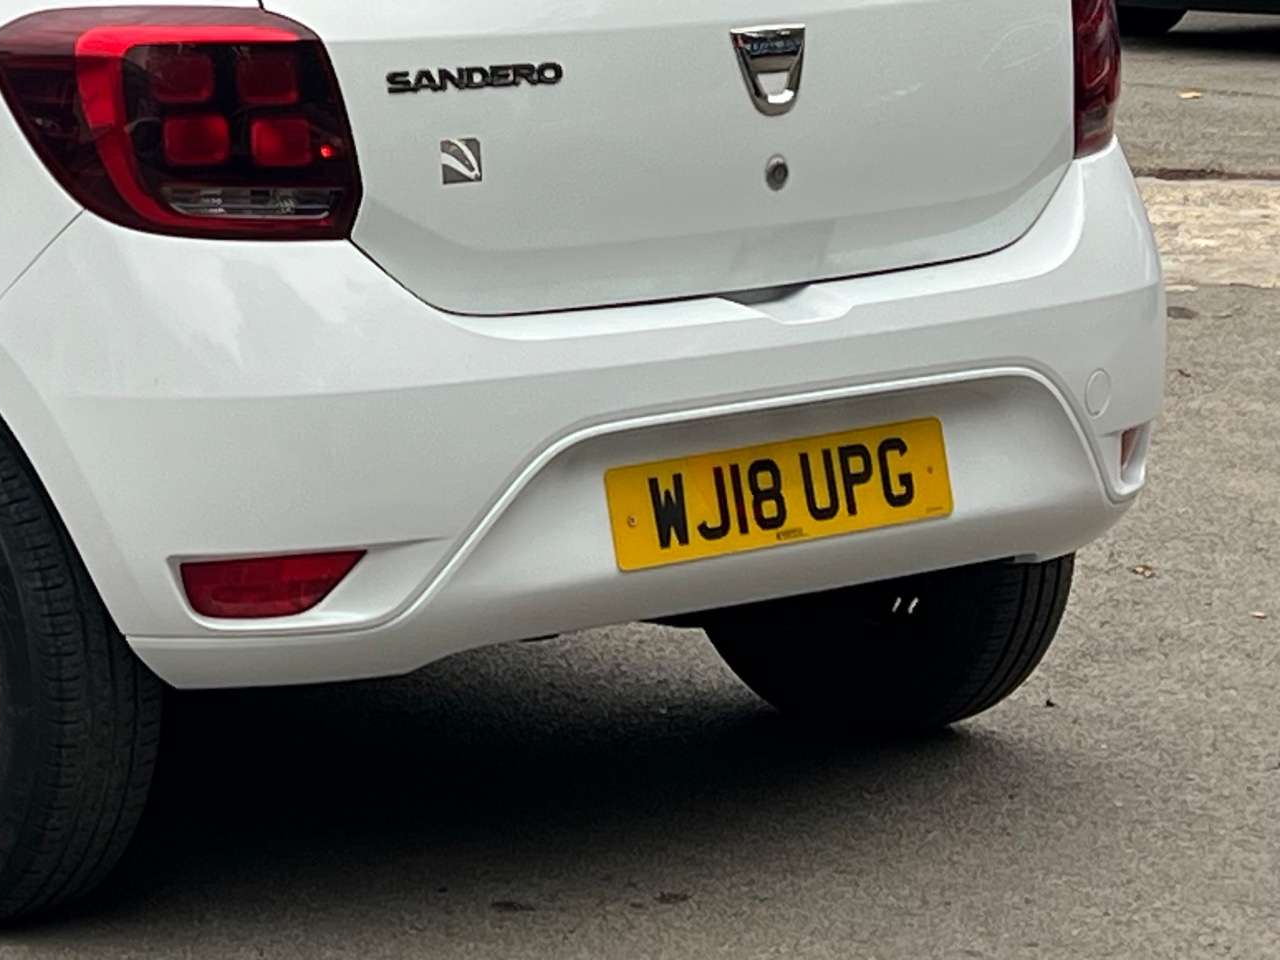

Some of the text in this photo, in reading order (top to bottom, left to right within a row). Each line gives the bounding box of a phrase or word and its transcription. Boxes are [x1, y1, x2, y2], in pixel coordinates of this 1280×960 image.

[386, 62, 564, 95] SANDERO
[647, 437, 915, 550] WJ18 UPG
